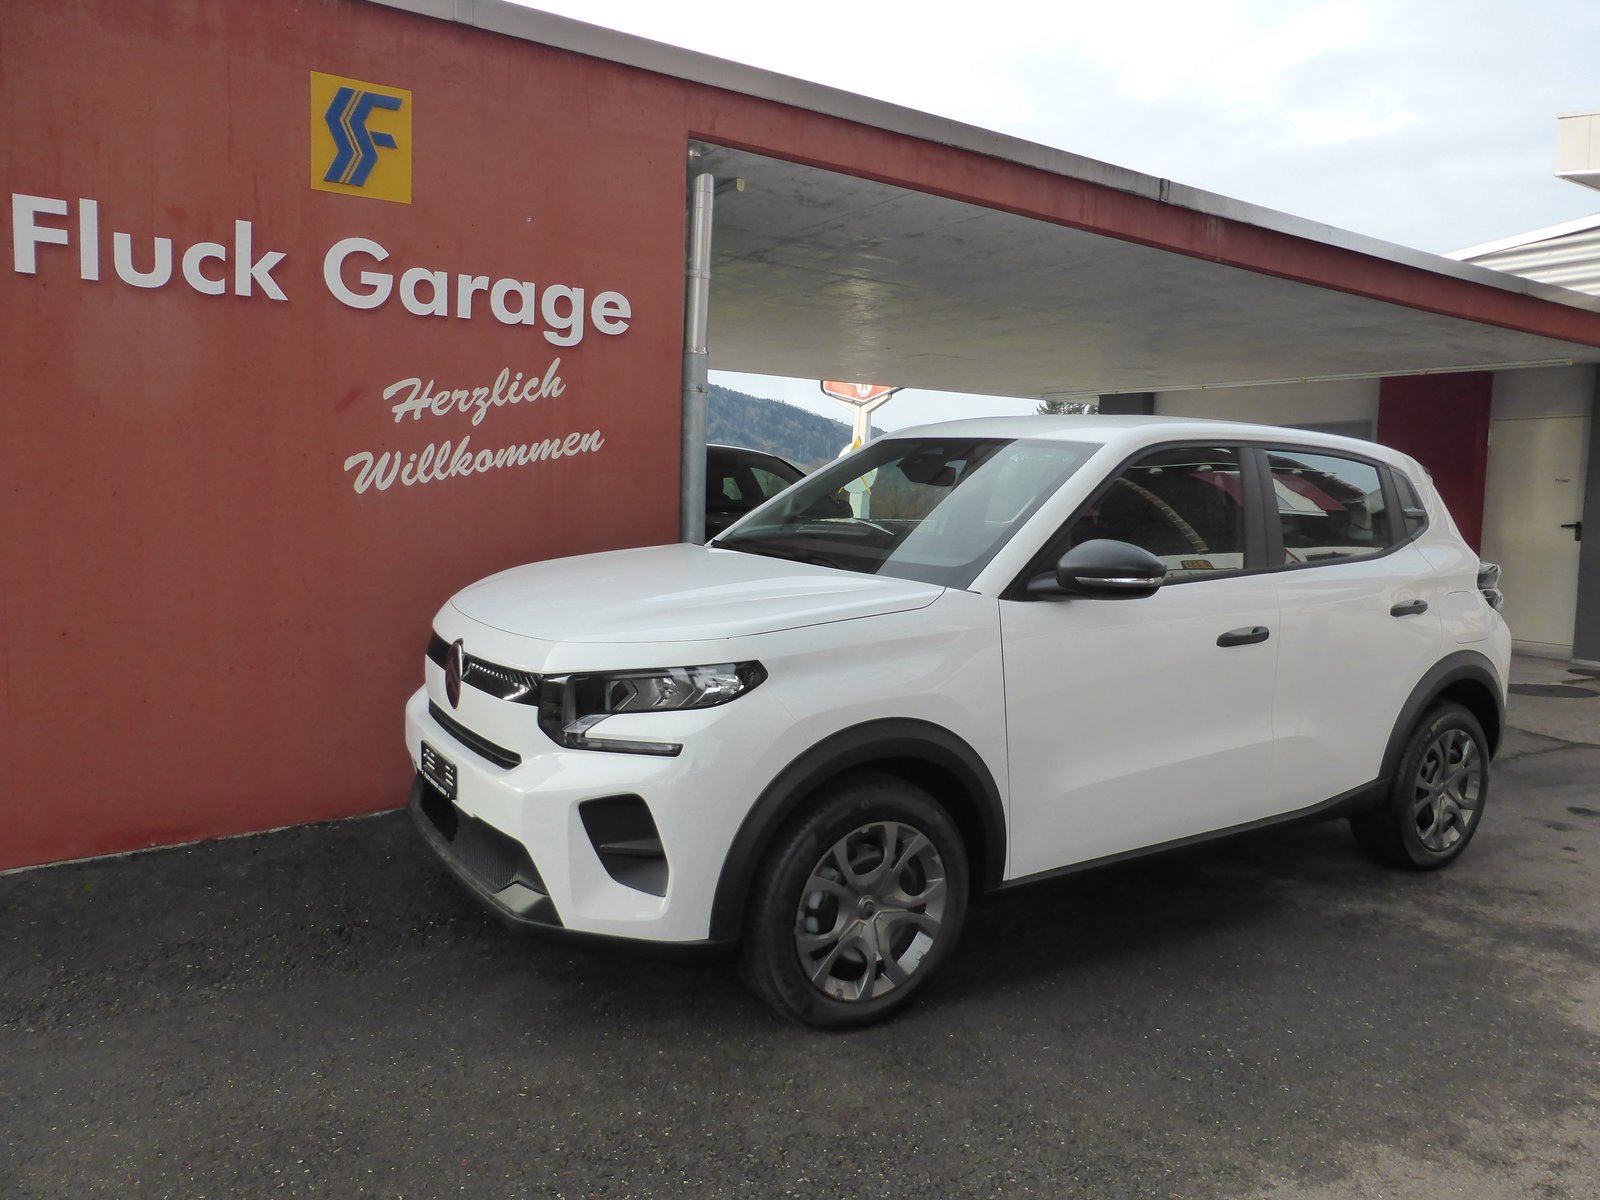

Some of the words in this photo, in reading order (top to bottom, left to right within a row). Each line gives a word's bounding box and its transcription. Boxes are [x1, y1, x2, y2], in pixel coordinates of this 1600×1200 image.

[11, 193, 289, 302] Fluck
[323, 237, 633, 347] Garage
[382, 357, 567, 427] Herzlich
[343, 426, 605, 495] Willkommen
